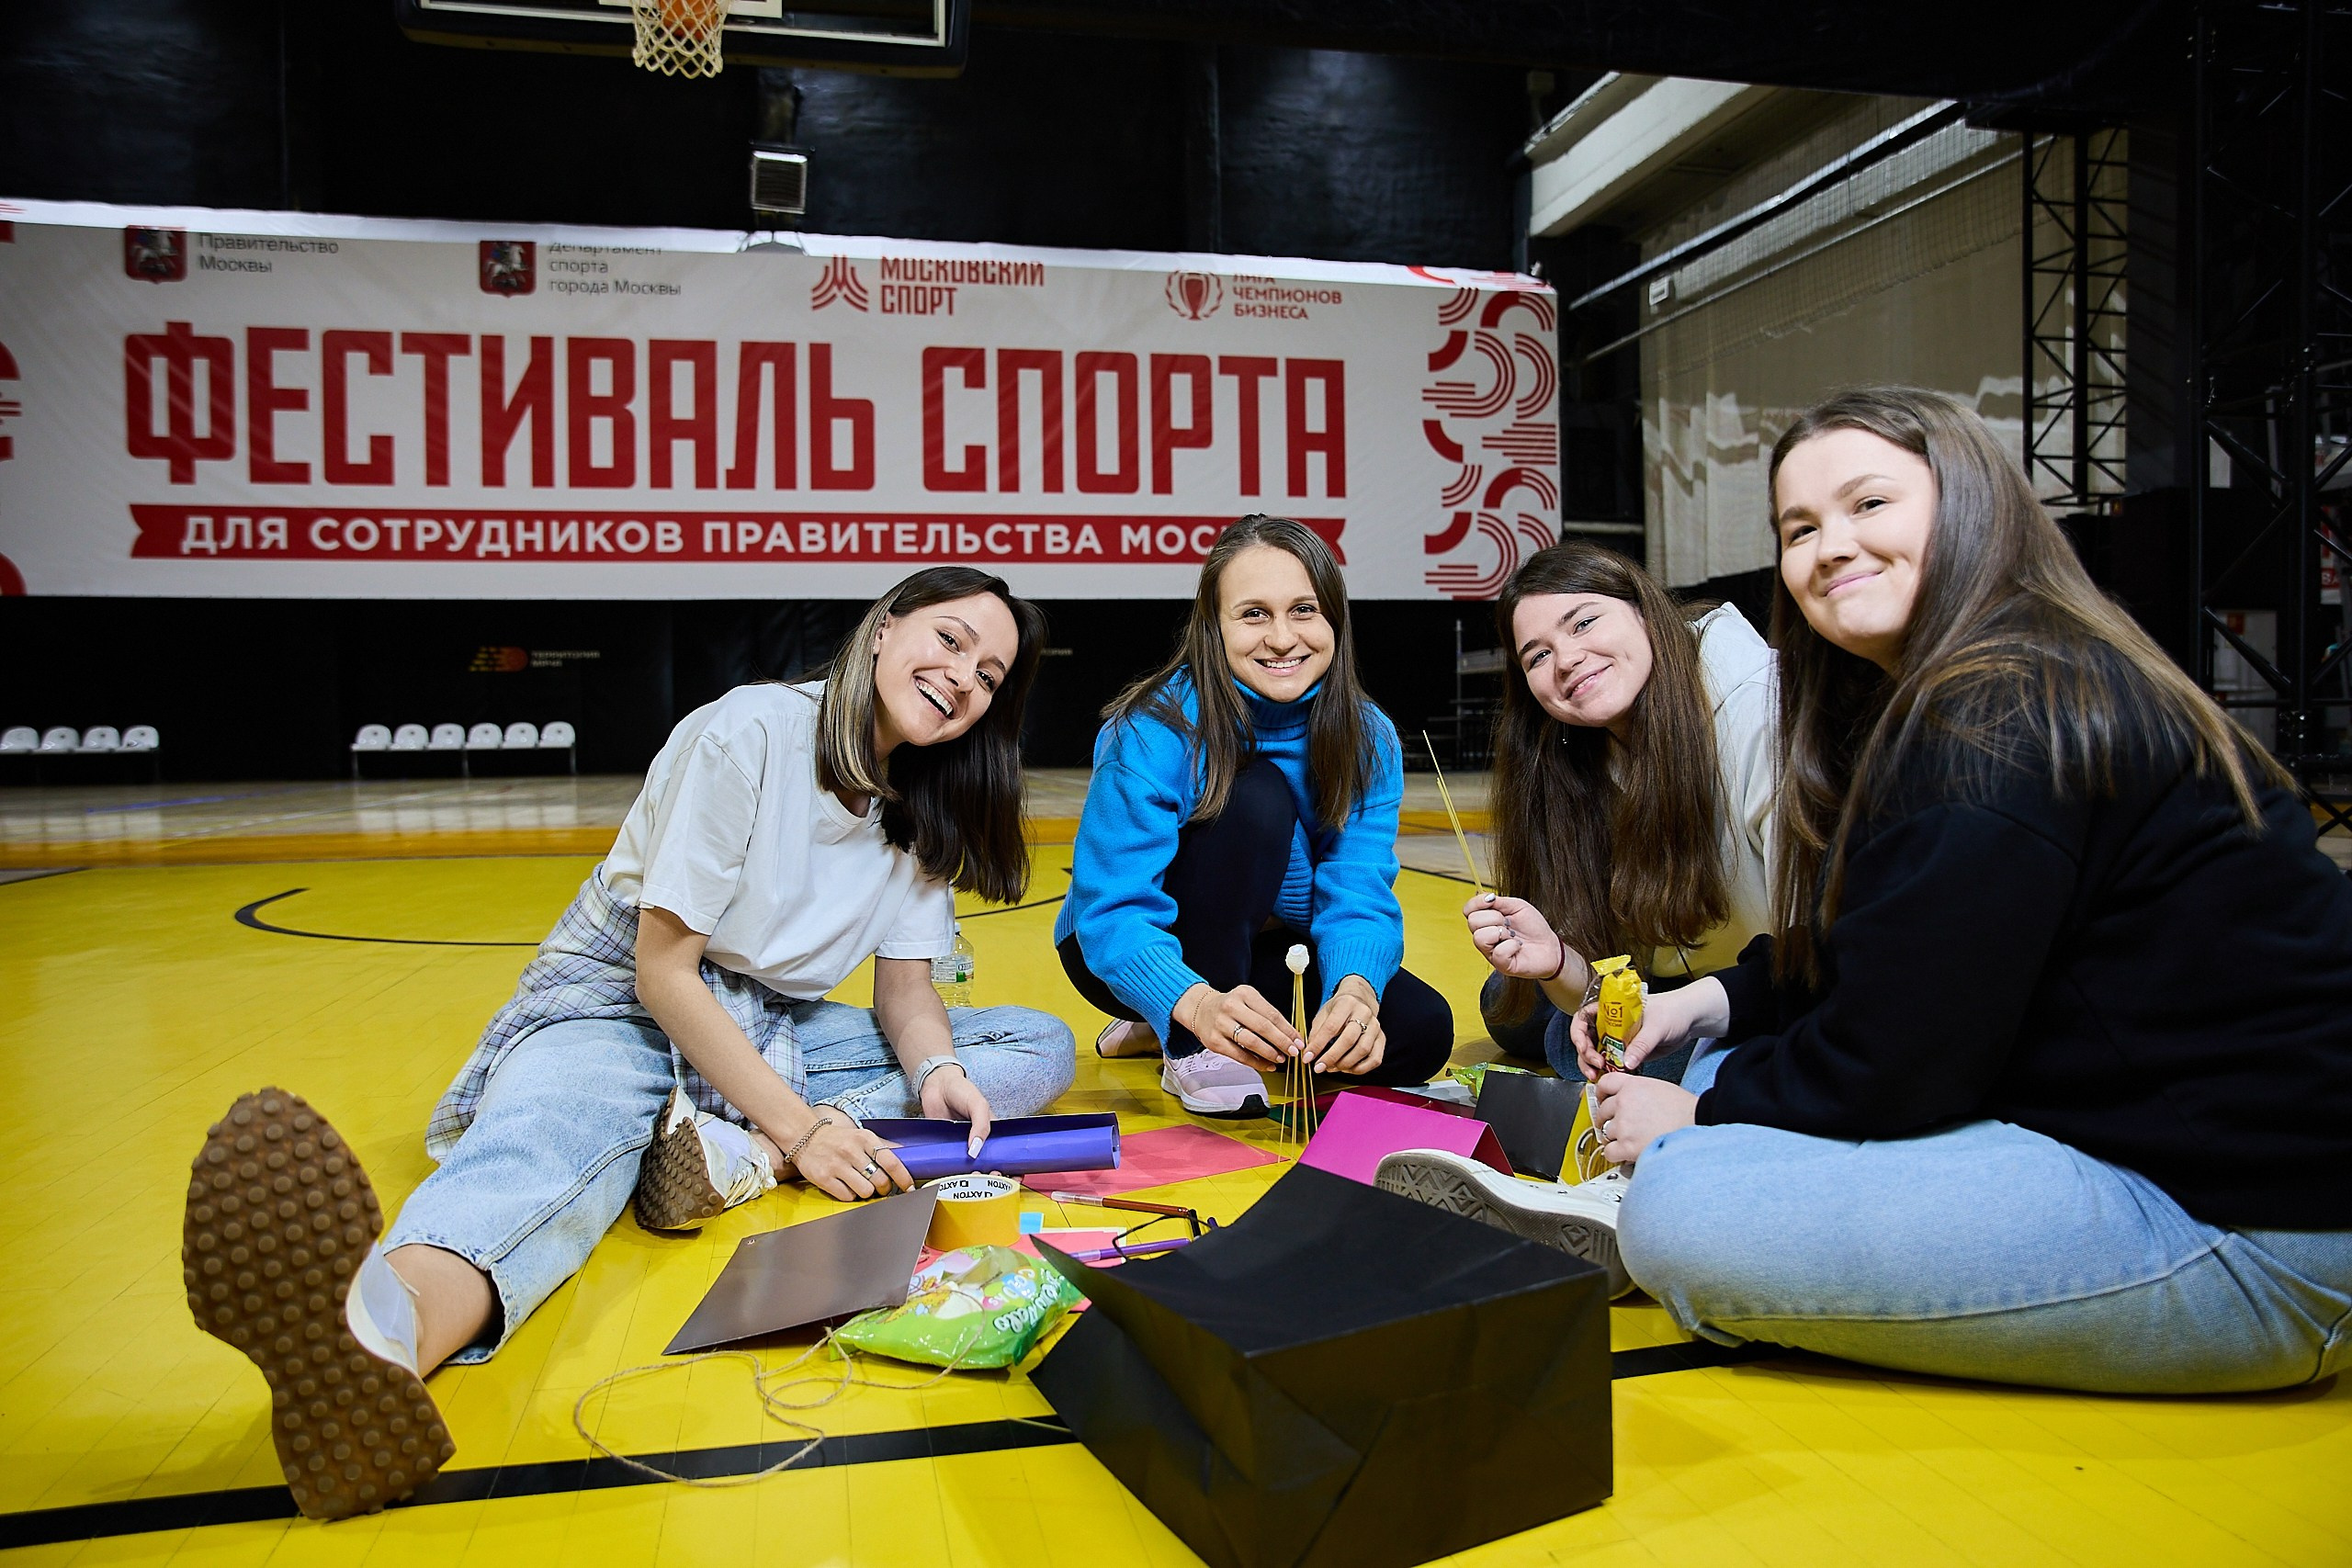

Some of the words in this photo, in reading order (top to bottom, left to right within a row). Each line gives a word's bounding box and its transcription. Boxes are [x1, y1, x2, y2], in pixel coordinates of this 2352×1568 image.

[198, 233, 339, 254] Правительство
[198, 254, 273, 273] Москвы
[549, 260, 609, 275] спорта
[550, 280, 609, 296] города
[615, 280, 682, 296] Москвы
[1232, 287, 1342, 305] ЧЕМПИОНОВ
[880, 285, 958, 315] СПОРТ
[1233, 304, 1309, 320] БИЗНЕСА
[125, 321, 876, 492] ФЕСТИВАЛЬ
[922, 346, 1346, 500] СПОРТА
[182, 516, 288, 555] ДЛЯ
[310, 518, 684, 558] СОТРУДНИКОВ
[703, 521, 1103, 556] ПРАВИТЕЛЬСТВА
[1120, 525, 1226, 556] МОС
[939, 1180, 958, 1191] AXTO
[953, 1190, 983, 1200] AXTON
